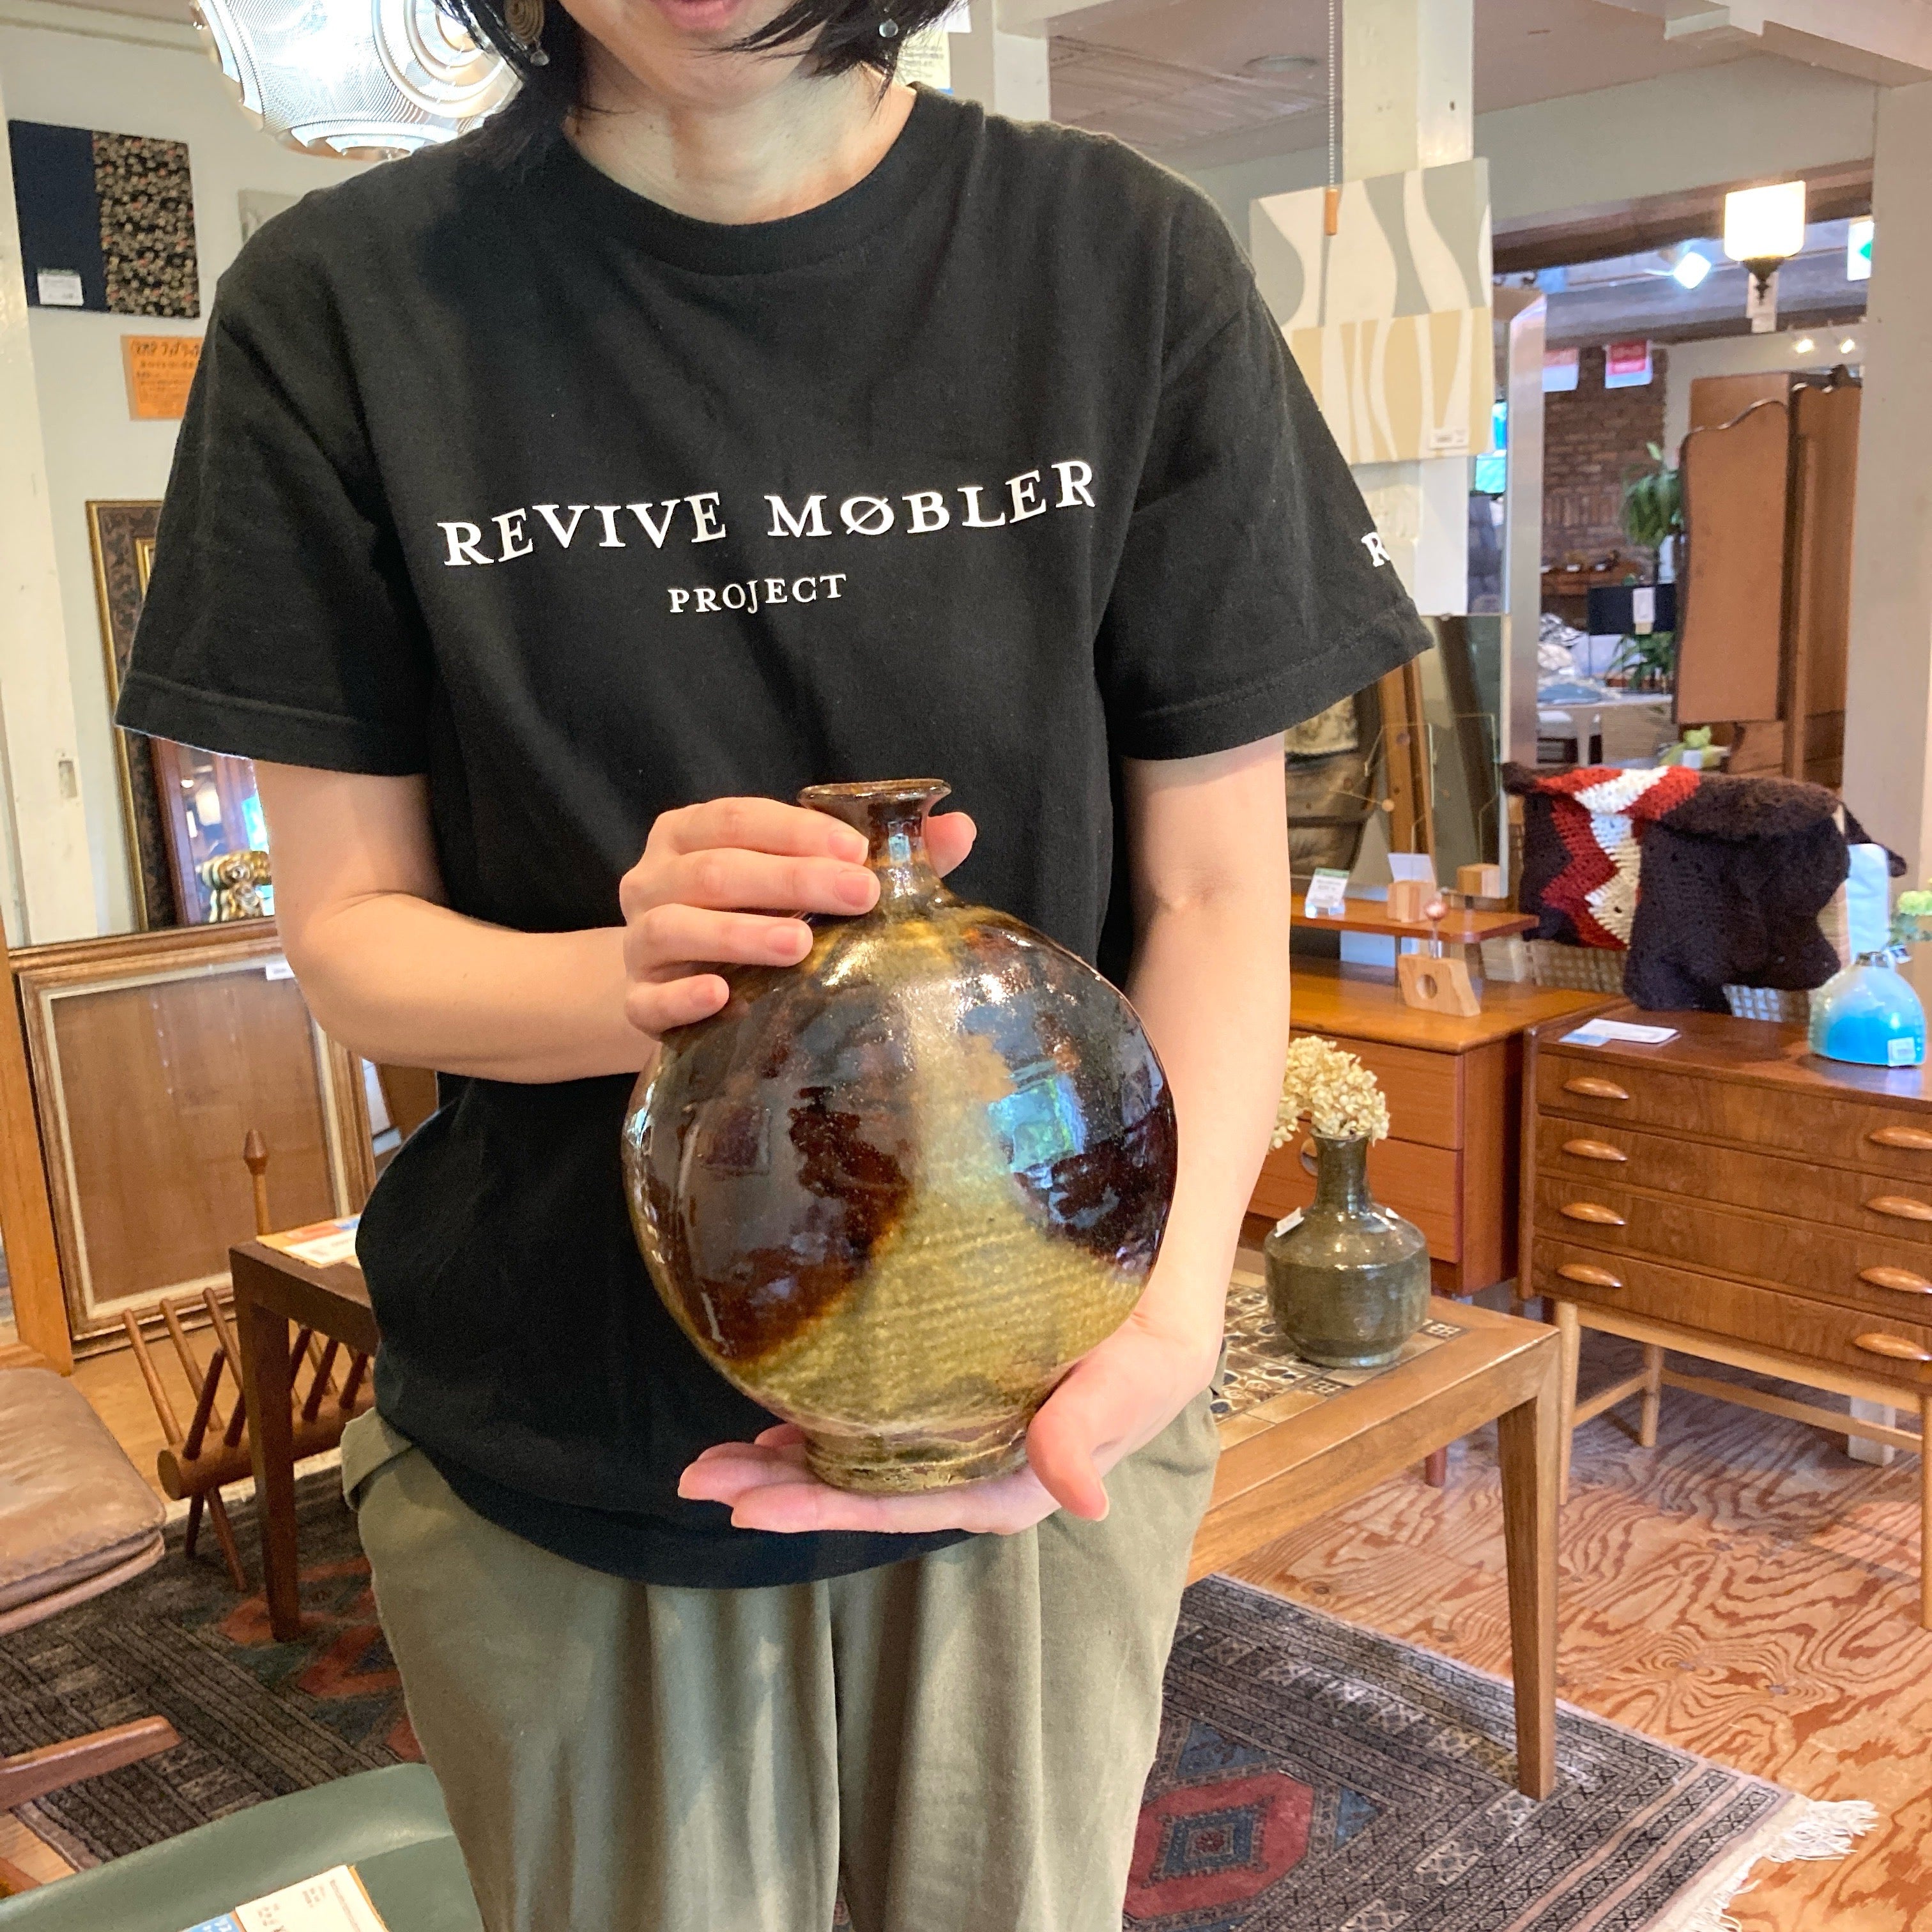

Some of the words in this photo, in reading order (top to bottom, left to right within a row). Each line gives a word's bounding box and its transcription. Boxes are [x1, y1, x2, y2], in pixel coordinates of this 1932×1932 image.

[436, 491, 726, 567] REVIVE
[763, 459, 1096, 539] MØBLER
[666, 573, 847, 614] PROJECT
